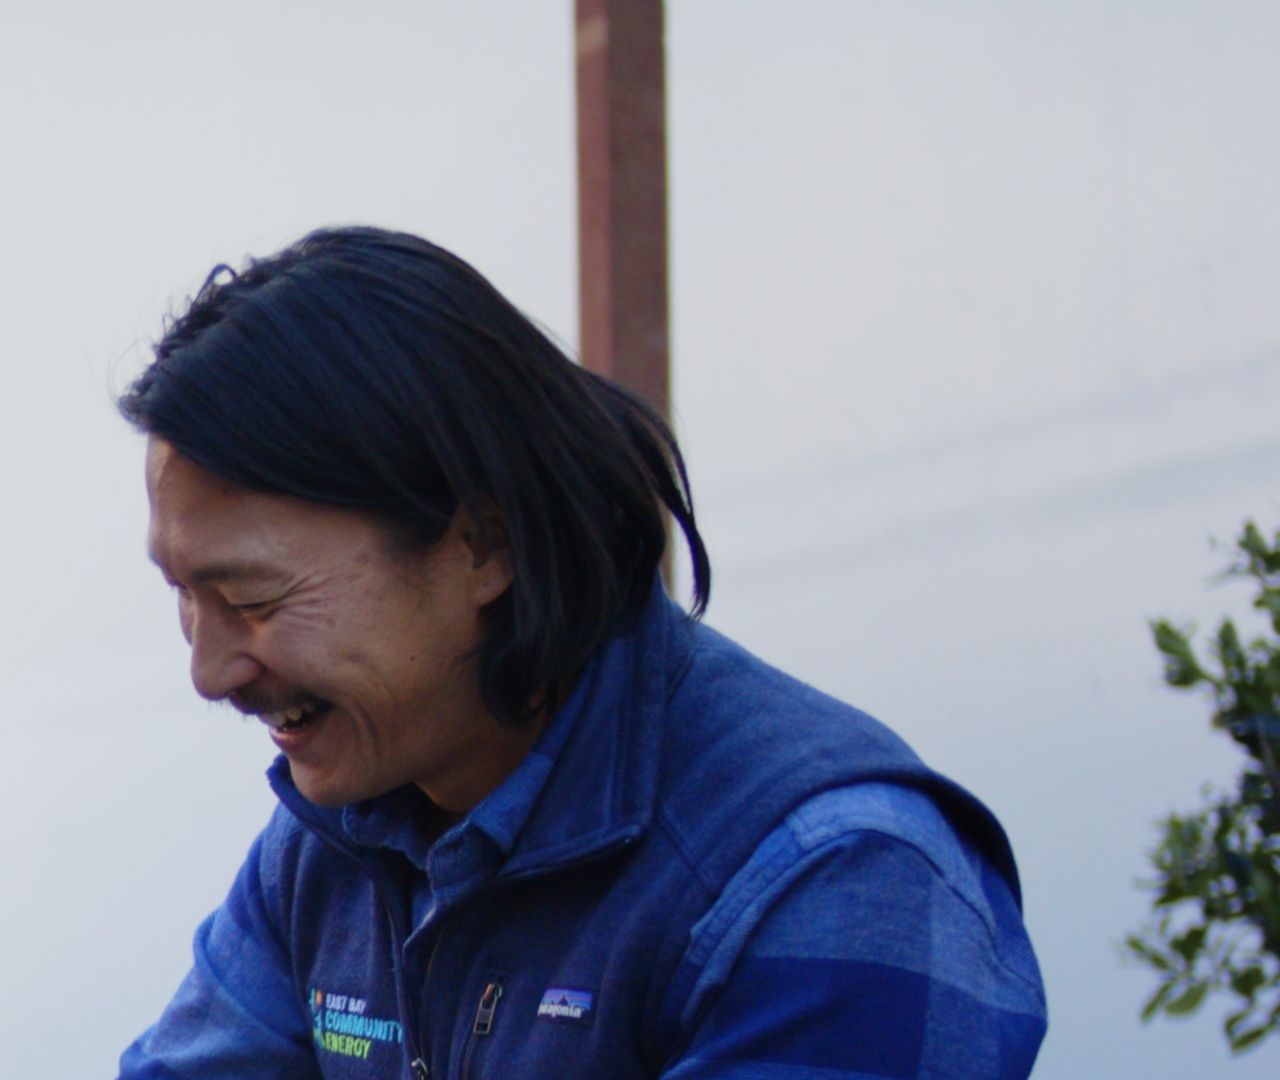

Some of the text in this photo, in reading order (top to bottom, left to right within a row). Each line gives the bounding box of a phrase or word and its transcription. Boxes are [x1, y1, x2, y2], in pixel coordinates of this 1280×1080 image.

[325, 993, 367, 1014] EAST BAY
[325, 1010, 403, 1043] COMMUNITY
[325, 1032, 372, 1060] ENERGY
